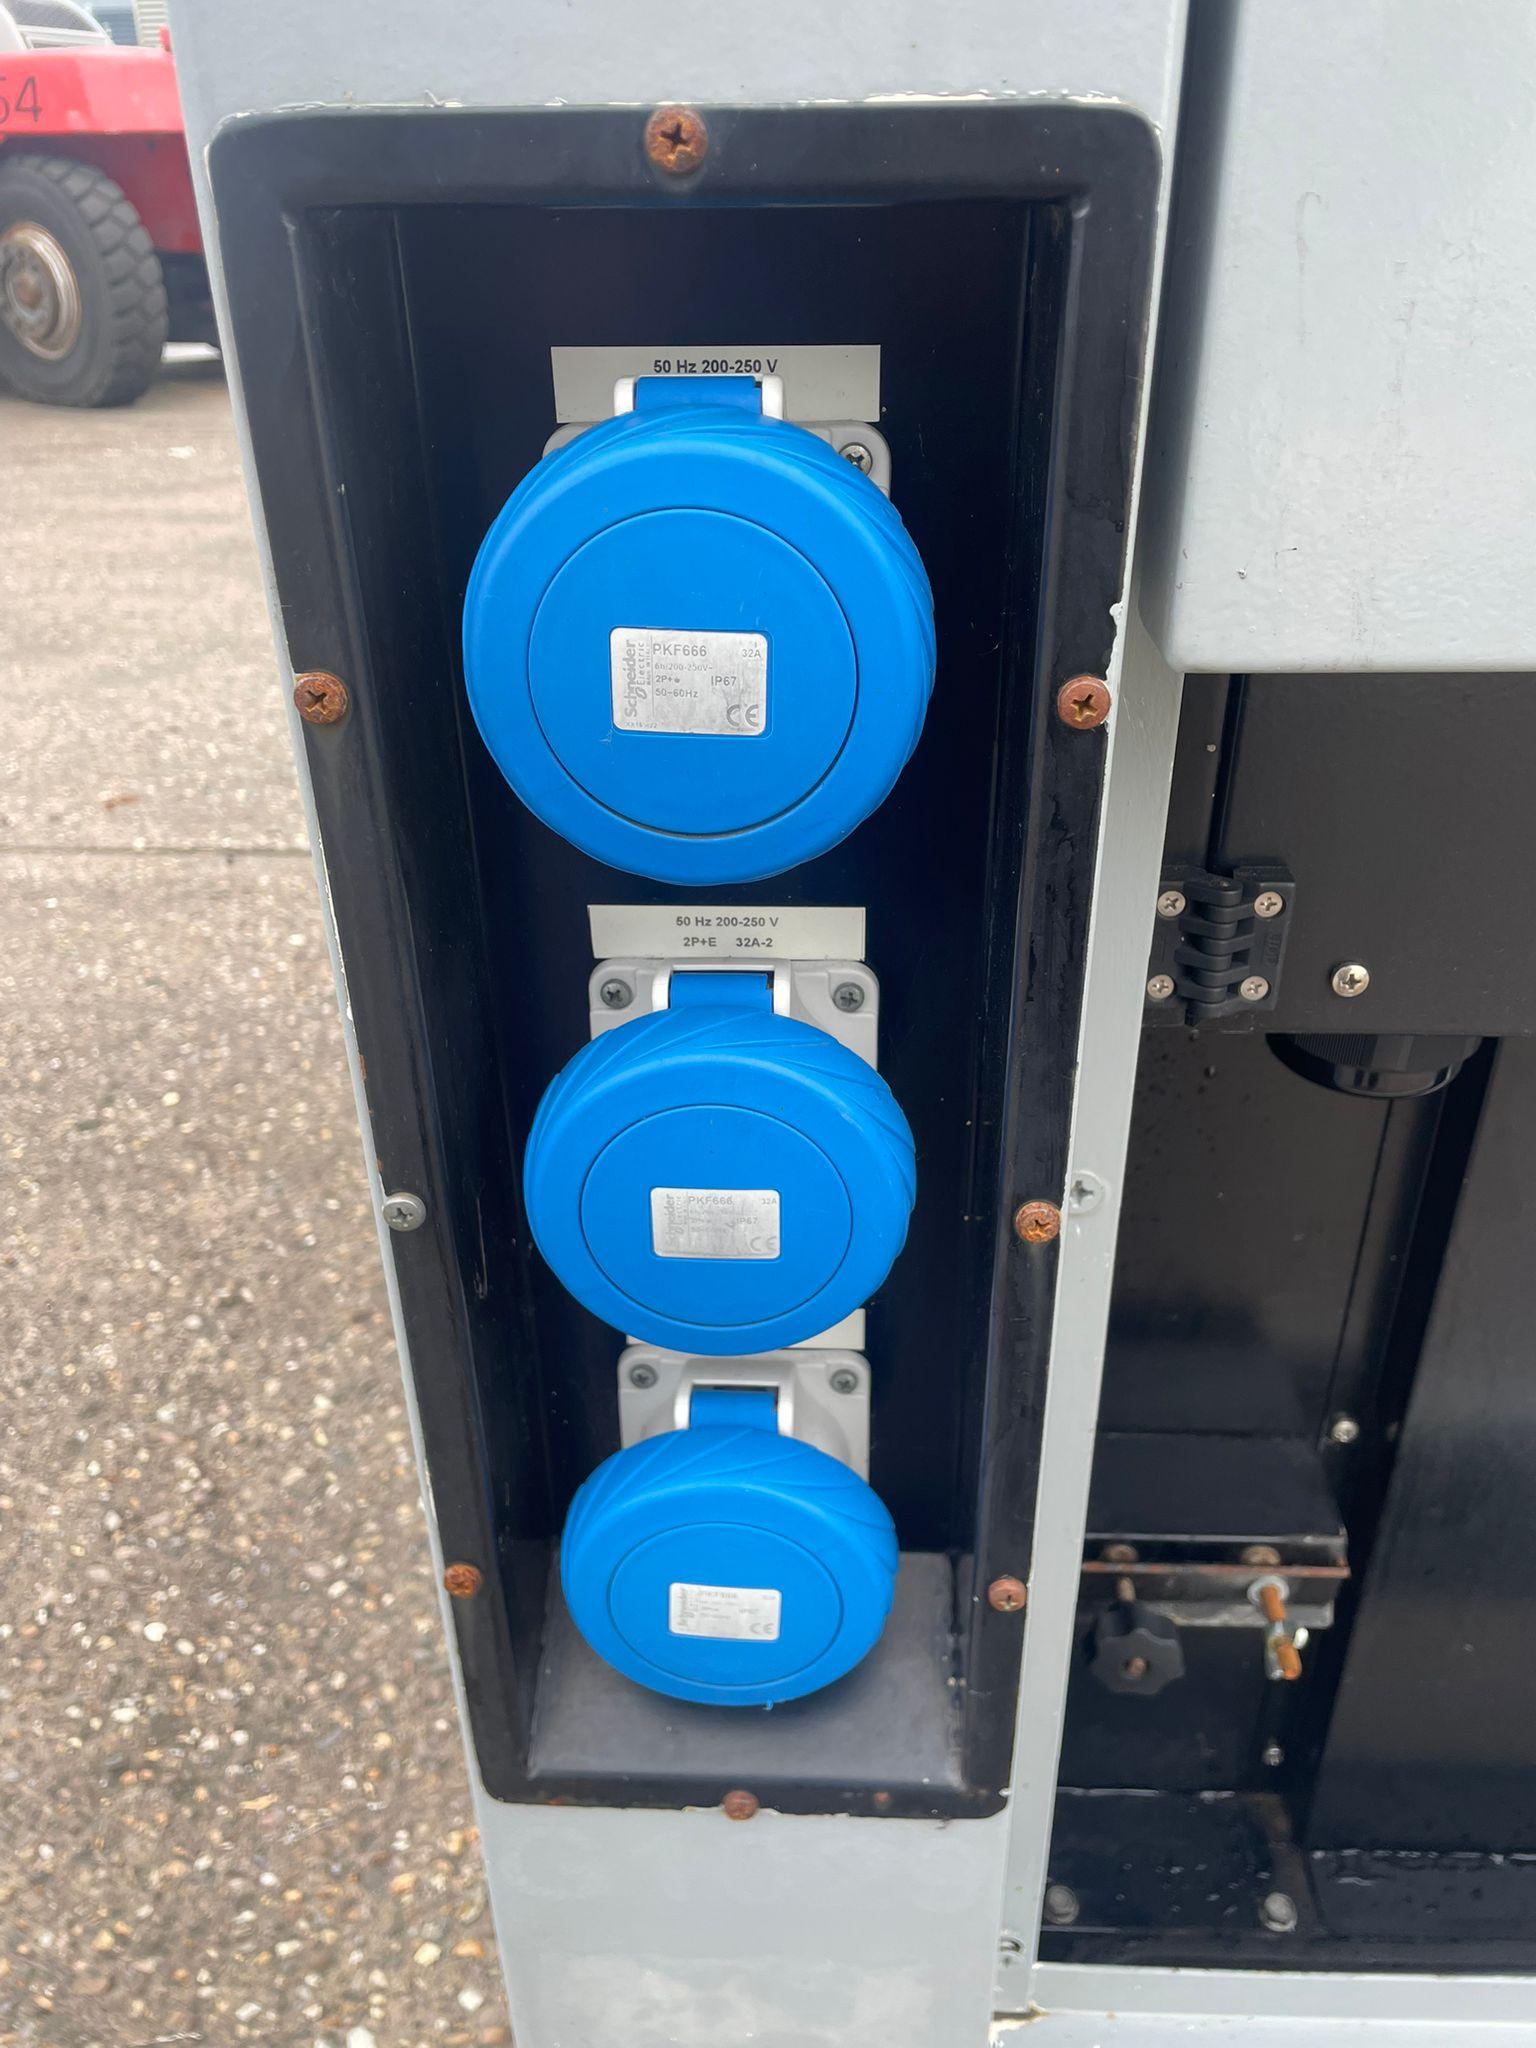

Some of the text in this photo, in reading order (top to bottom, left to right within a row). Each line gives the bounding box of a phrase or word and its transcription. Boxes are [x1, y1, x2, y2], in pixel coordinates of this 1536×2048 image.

[653, 359, 778, 374] 50 Hz 200-250 V
[653, 643, 708, 657] PKF666
[742, 648, 761, 658] 32A
[622, 639, 637, 718] Schneider
[711, 675, 737, 687] IP67
[676, 917, 779, 927] 50 Hz 200-250 V
[683, 937, 773, 948] 2P+E 32A-2
[688, 1195, 733, 1206] PKF666
